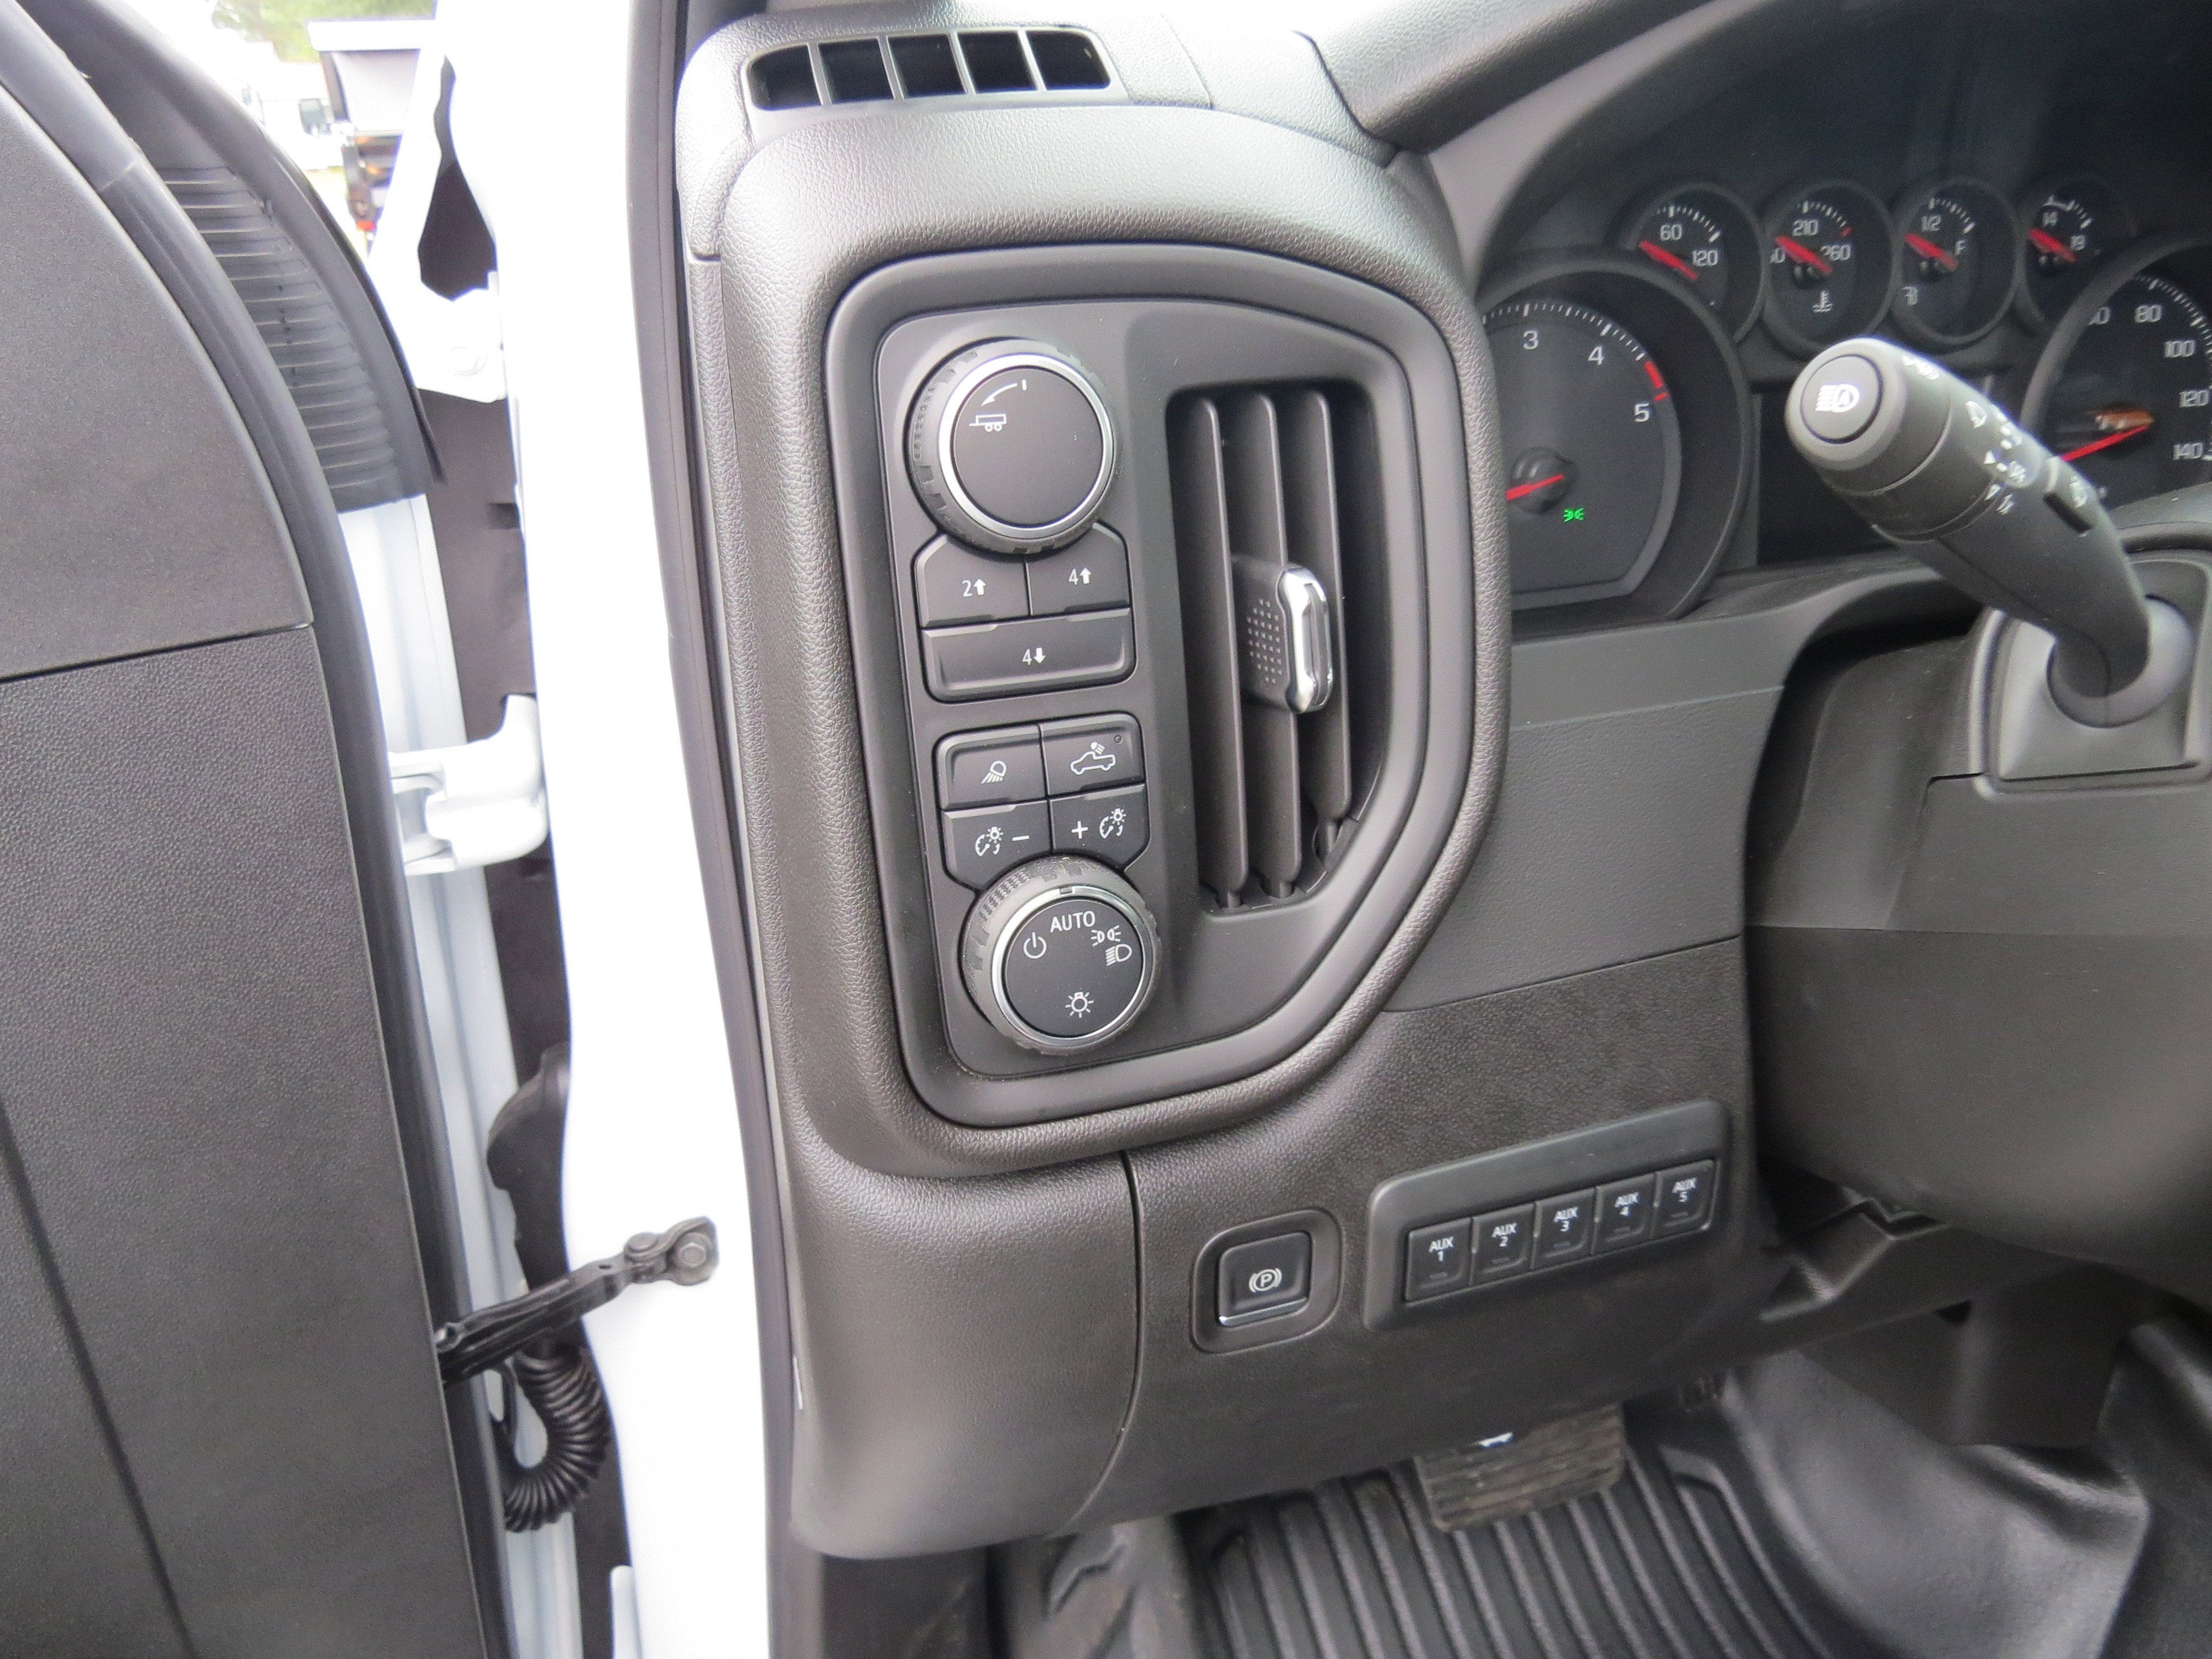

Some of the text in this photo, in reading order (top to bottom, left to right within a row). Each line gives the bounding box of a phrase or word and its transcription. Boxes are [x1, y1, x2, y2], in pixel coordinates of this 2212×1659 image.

[1660, 224, 1682, 240] 60
[1955, 239, 1966, 256] F
[1692, 249, 1718, 266] 120
[2135, 304, 2162, 323] 80
[1522, 331, 1539, 350] 3
[2164, 339, 2195, 358] 100
[1588, 345, 1604, 366] 4
[2179, 389, 2210, 408] 120
[1634, 402, 1650, 422] 5
[2173, 442, 2203, 461] 140
[1050, 910, 1096, 933] AUTO
[1671, 1177, 1697, 1193] AUX
[1614, 1192, 1639, 1208] AUX
[1678, 1191, 1687, 1203] 5
[1553, 1207, 1578, 1222] AUX
[1491, 1223, 1516, 1238] AUX
[1560, 1220, 1570, 1232] 3
[1428, 1237, 1454, 1253] AUX
[1499, 1235, 1508, 1247] 2
[1437, 1251, 1444, 1261] 1
